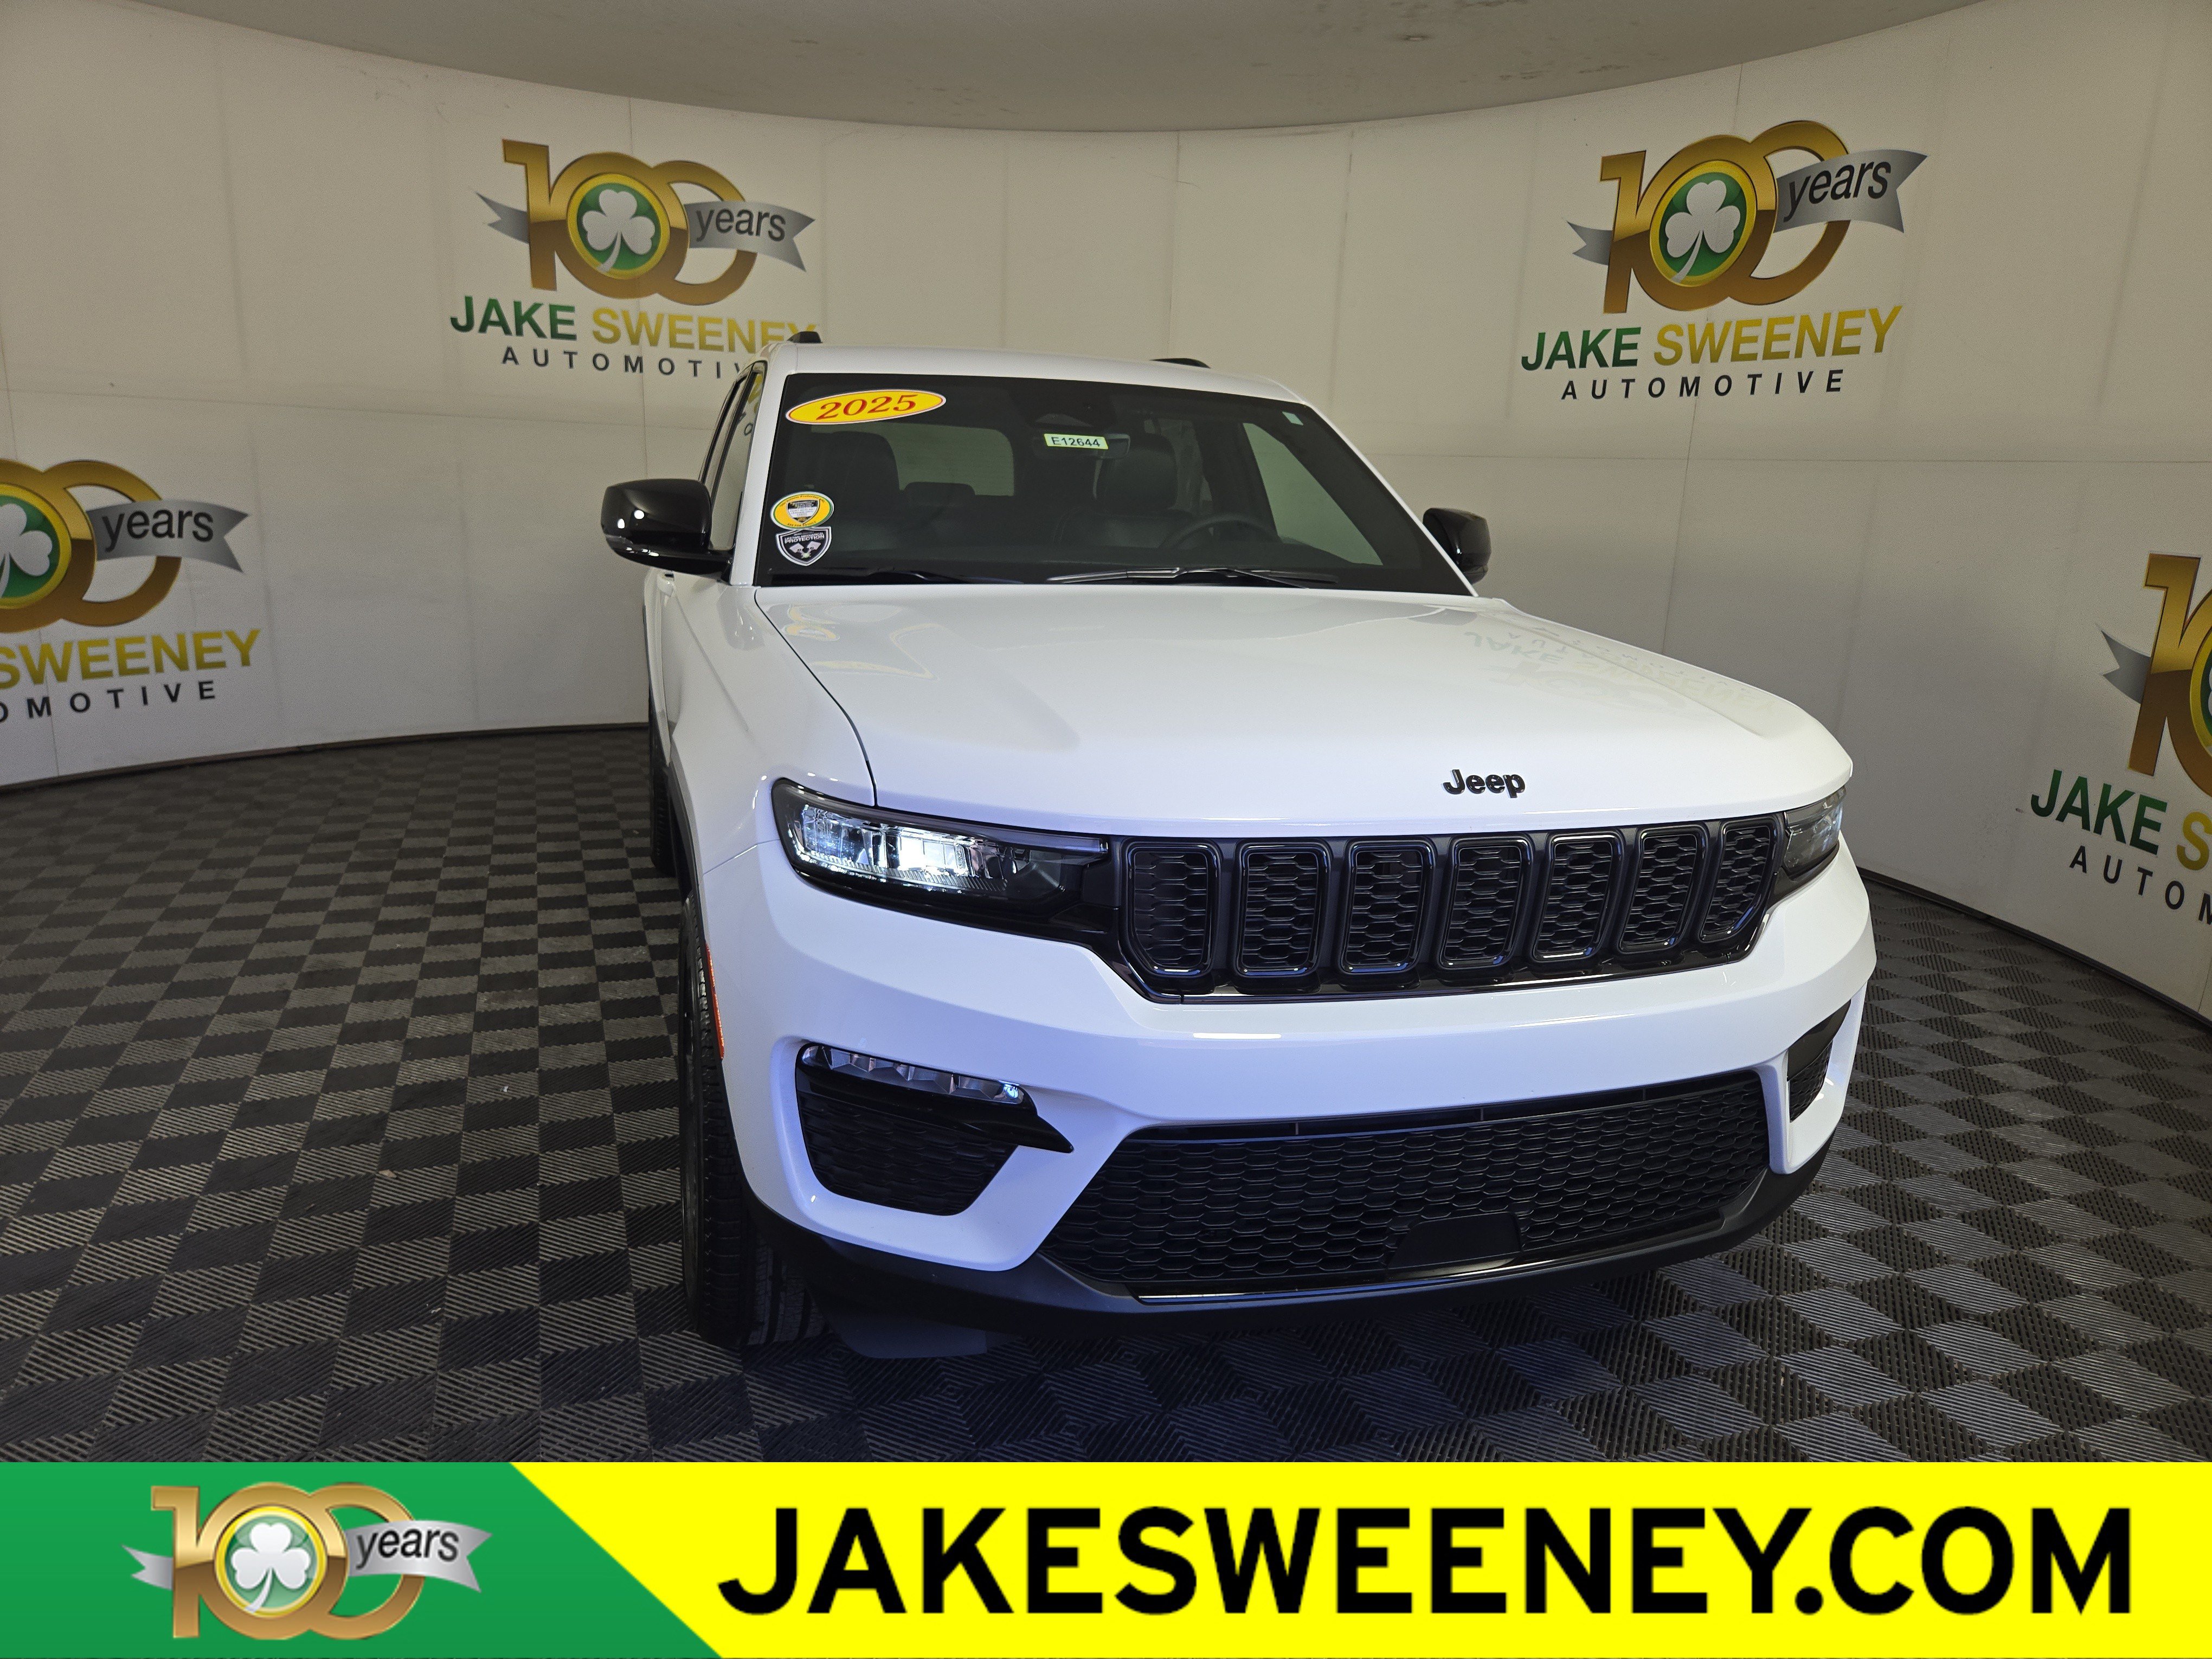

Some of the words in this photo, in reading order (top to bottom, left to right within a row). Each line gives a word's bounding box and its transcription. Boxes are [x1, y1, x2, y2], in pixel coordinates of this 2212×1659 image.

[503, 139, 757, 305] 100
[695, 208, 786, 242] years
[1600, 120, 1851, 313] 100
[1784, 161, 1891, 222] years
[450, 295, 577, 340] JAKE
[1521, 327, 1641, 370] JAKE
[1654, 306, 1902, 366] SWEENEY
[503, 346, 740, 380] AUTOMOTI
[1562, 369, 1843, 400] AUTOMOTIVE
[816, 394, 918, 420] 2025
[1051, 436, 1100, 447] E12644
[102, 510, 214, 552] years
[0, 628, 260, 690] SWEENEY
[1443, 769, 1526, 799] Jeep
[2031, 769, 2168, 855] JAKE
